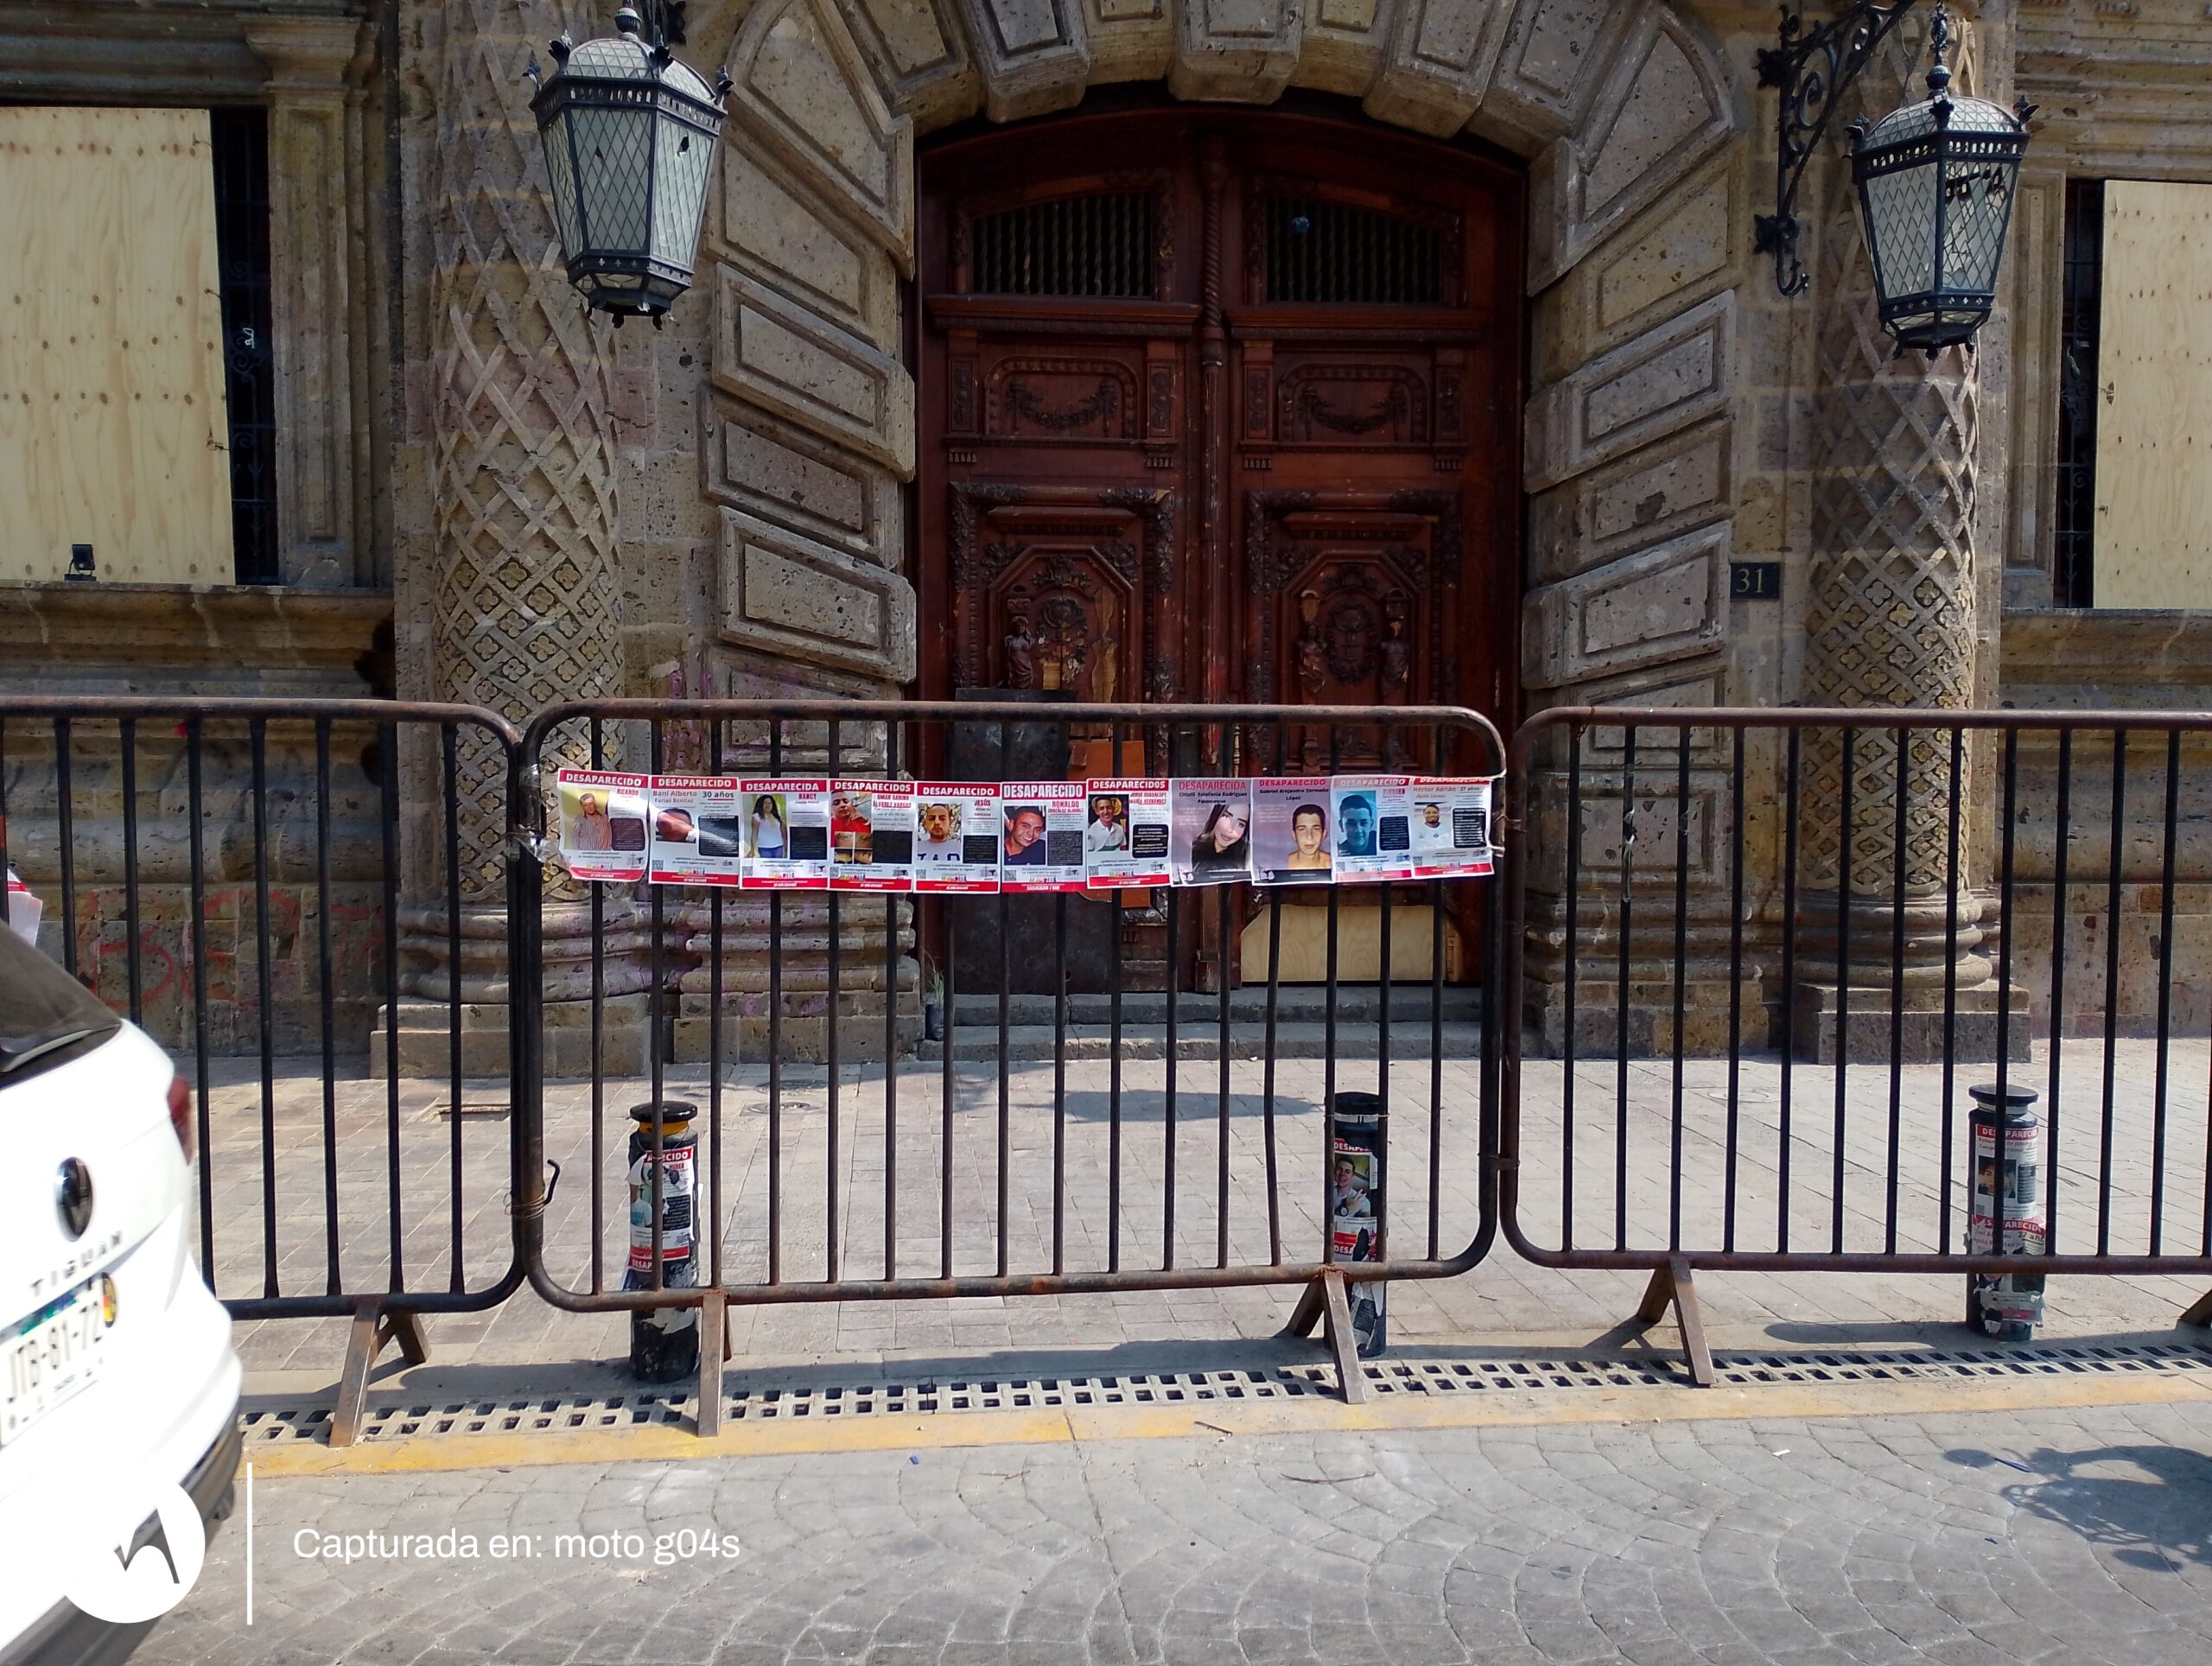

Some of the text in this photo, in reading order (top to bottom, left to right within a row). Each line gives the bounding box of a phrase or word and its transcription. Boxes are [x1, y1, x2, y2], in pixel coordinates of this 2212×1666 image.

[1735, 568, 1764, 594] 31
[566, 773, 642, 786] DESAPARECIDO
[658, 778, 732, 787] DESAPARECIDO
[1093, 780, 1166, 789] DESAPARECIDOS
[746, 782, 819, 791] DESAPARECIDA
[835, 781, 911, 792] DESAPARECIDOS
[1179, 781, 1246, 790] DESAPARECIDA
[923, 787, 994, 796] DESAPARECIDO
[1004, 785, 1083, 798] DESAPARECIDO
[29, 1230, 123, 1296] TIGUAN
